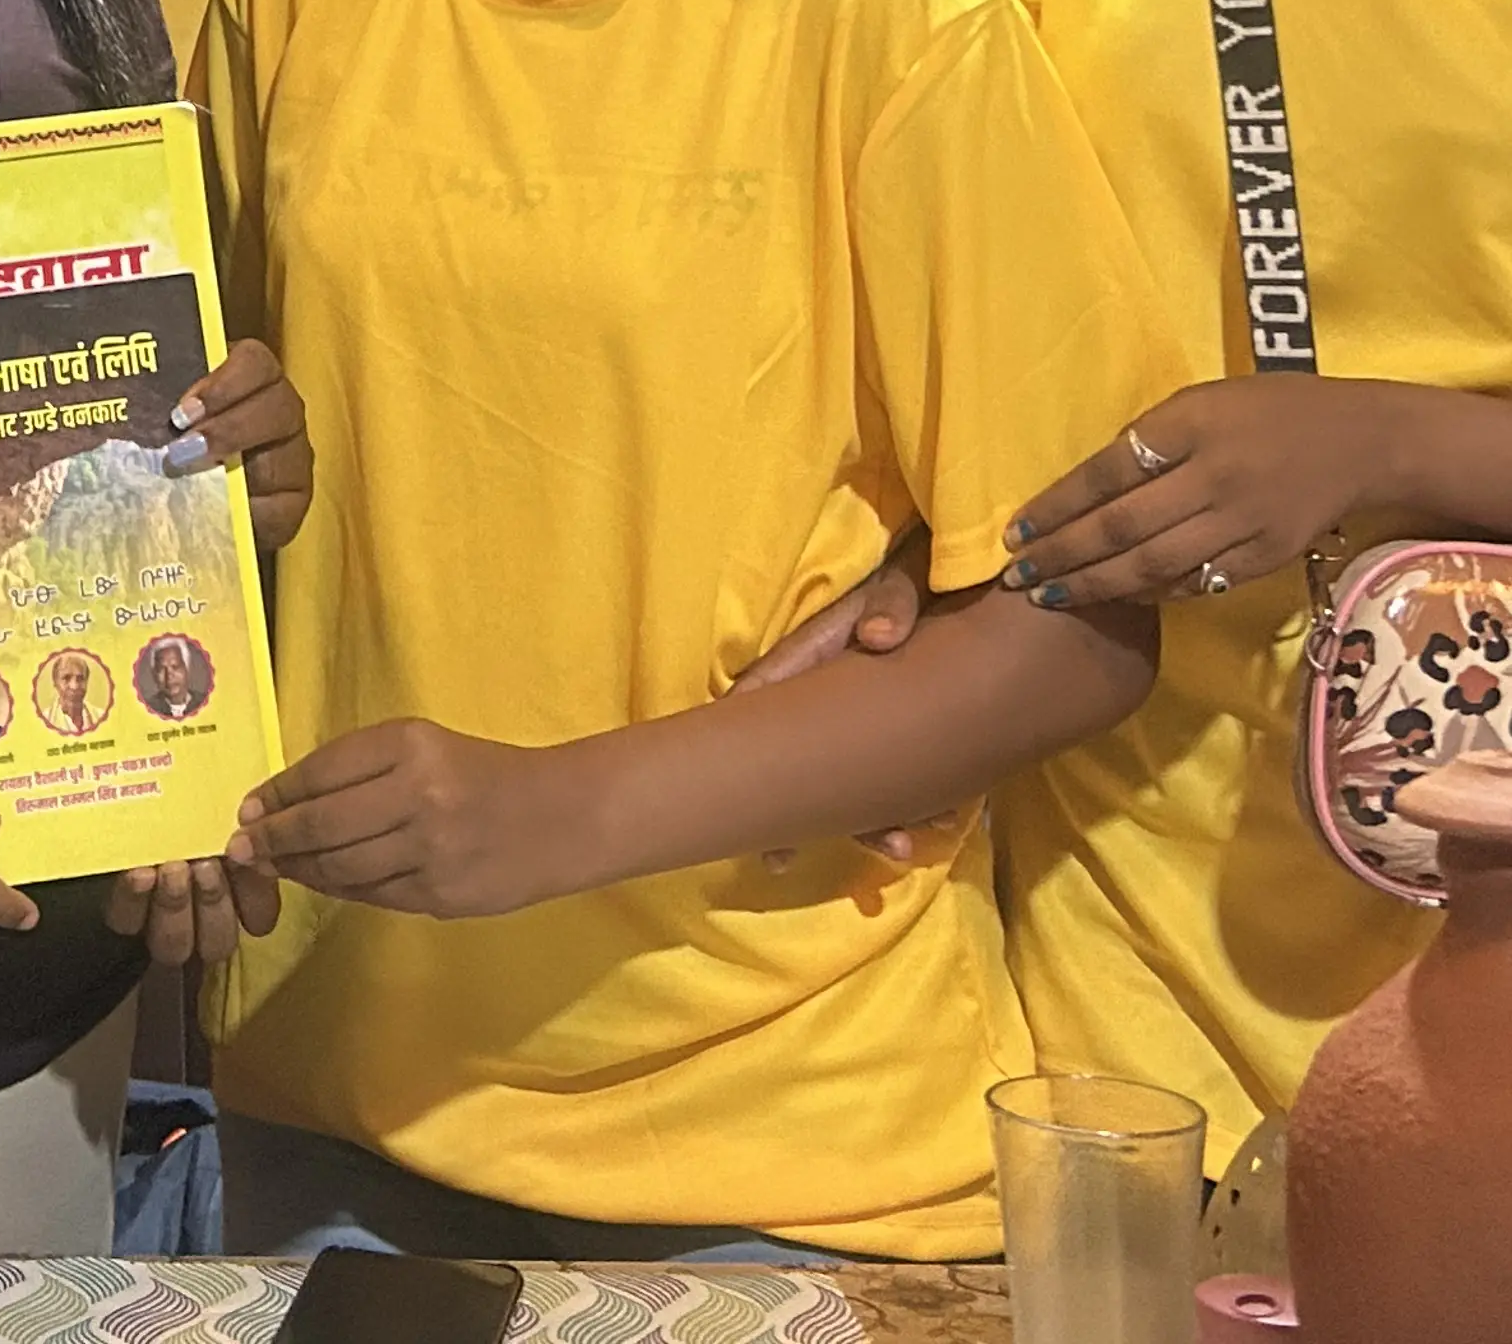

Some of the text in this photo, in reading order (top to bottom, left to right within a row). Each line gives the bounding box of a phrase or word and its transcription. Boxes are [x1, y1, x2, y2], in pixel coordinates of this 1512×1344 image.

[1224, 84, 1314, 359] FOREVER
[50, 341, 93, 382] एवं
[92, 331, 158, 379] लिपि
[22, 401, 58, 434] उण्डे
[60, 397, 128, 429] वनकाट
